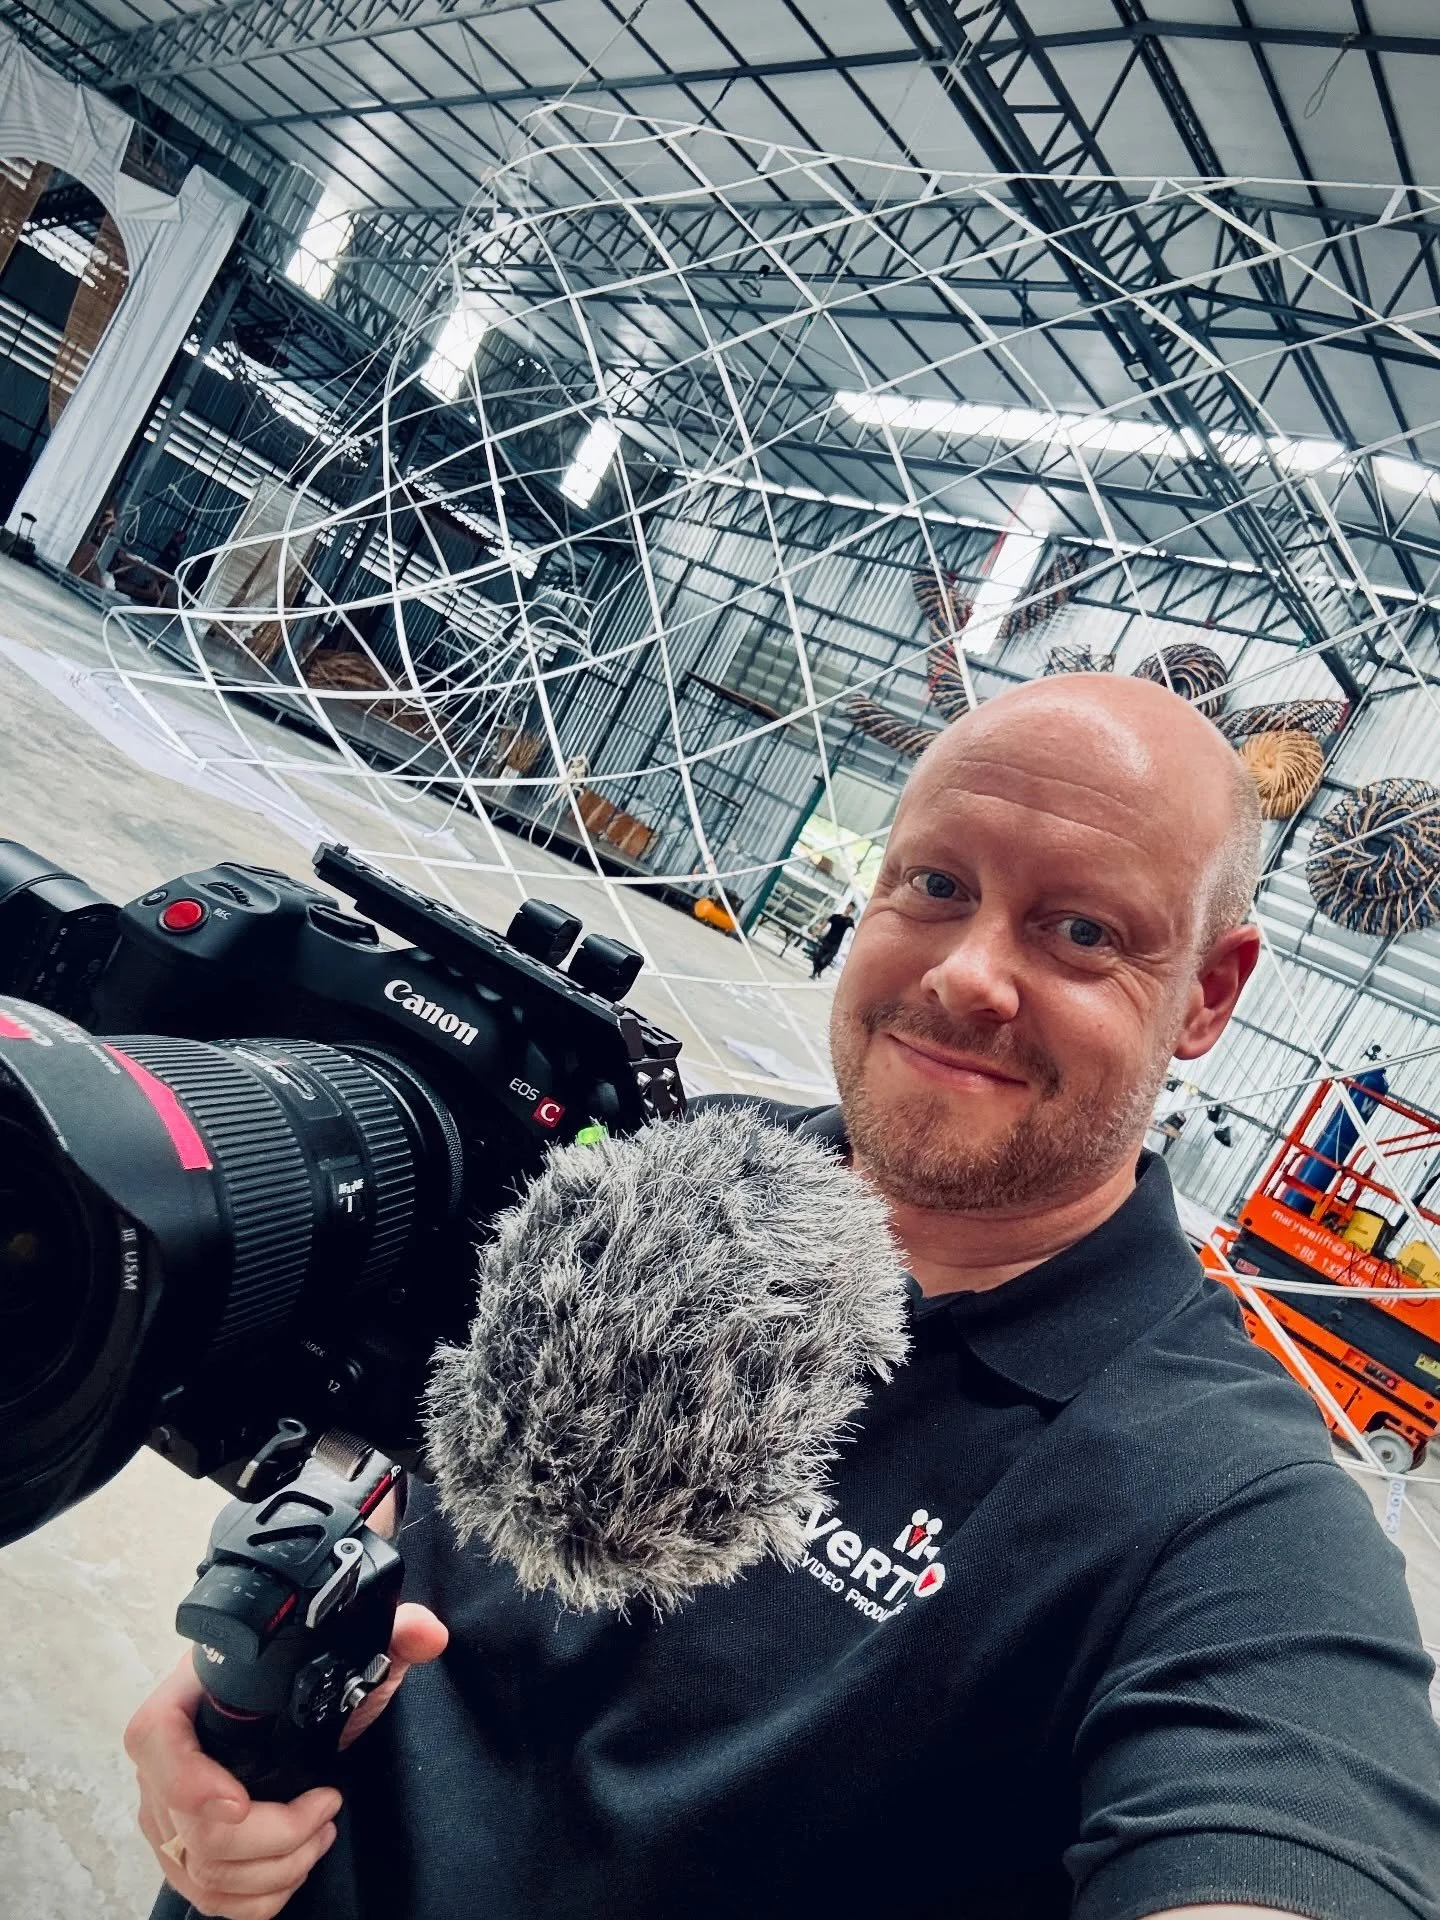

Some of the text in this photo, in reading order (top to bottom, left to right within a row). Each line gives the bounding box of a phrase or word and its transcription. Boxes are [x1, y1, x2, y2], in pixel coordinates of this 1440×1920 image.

[384, 979, 479, 1046] Canon
[509, 1077, 540, 1101] EOS
[124, 1251, 139, 1290] USM
[328, 1379, 341, 1394] 12
[800, 1551, 845, 1593] VIDEO
